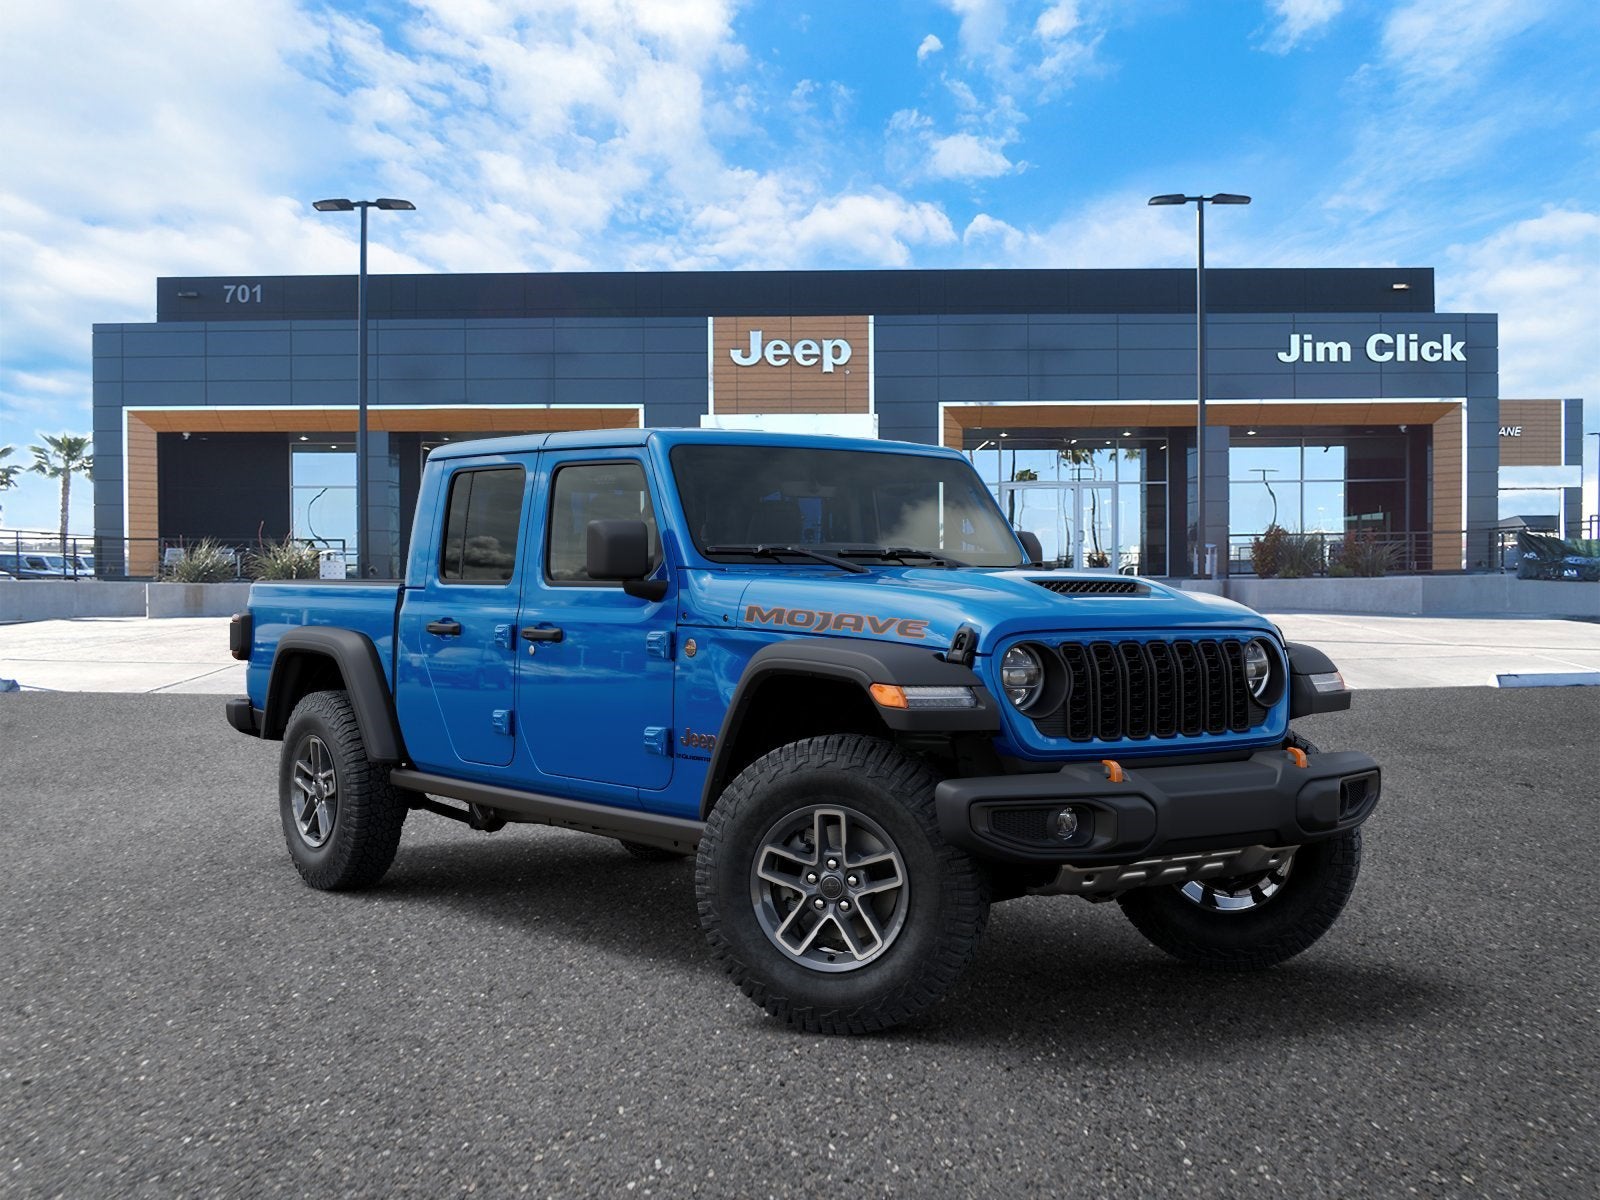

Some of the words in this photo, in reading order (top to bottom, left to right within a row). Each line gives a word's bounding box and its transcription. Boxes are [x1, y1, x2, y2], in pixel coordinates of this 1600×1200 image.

[223, 284, 262, 303] 701
[729, 330, 852, 373] Jeep
[1277, 333, 1352, 363] Jim
[1365, 333, 1467, 362] Click
[744, 604, 930, 640] MOJAVE
[680, 727, 717, 752] Jeep
